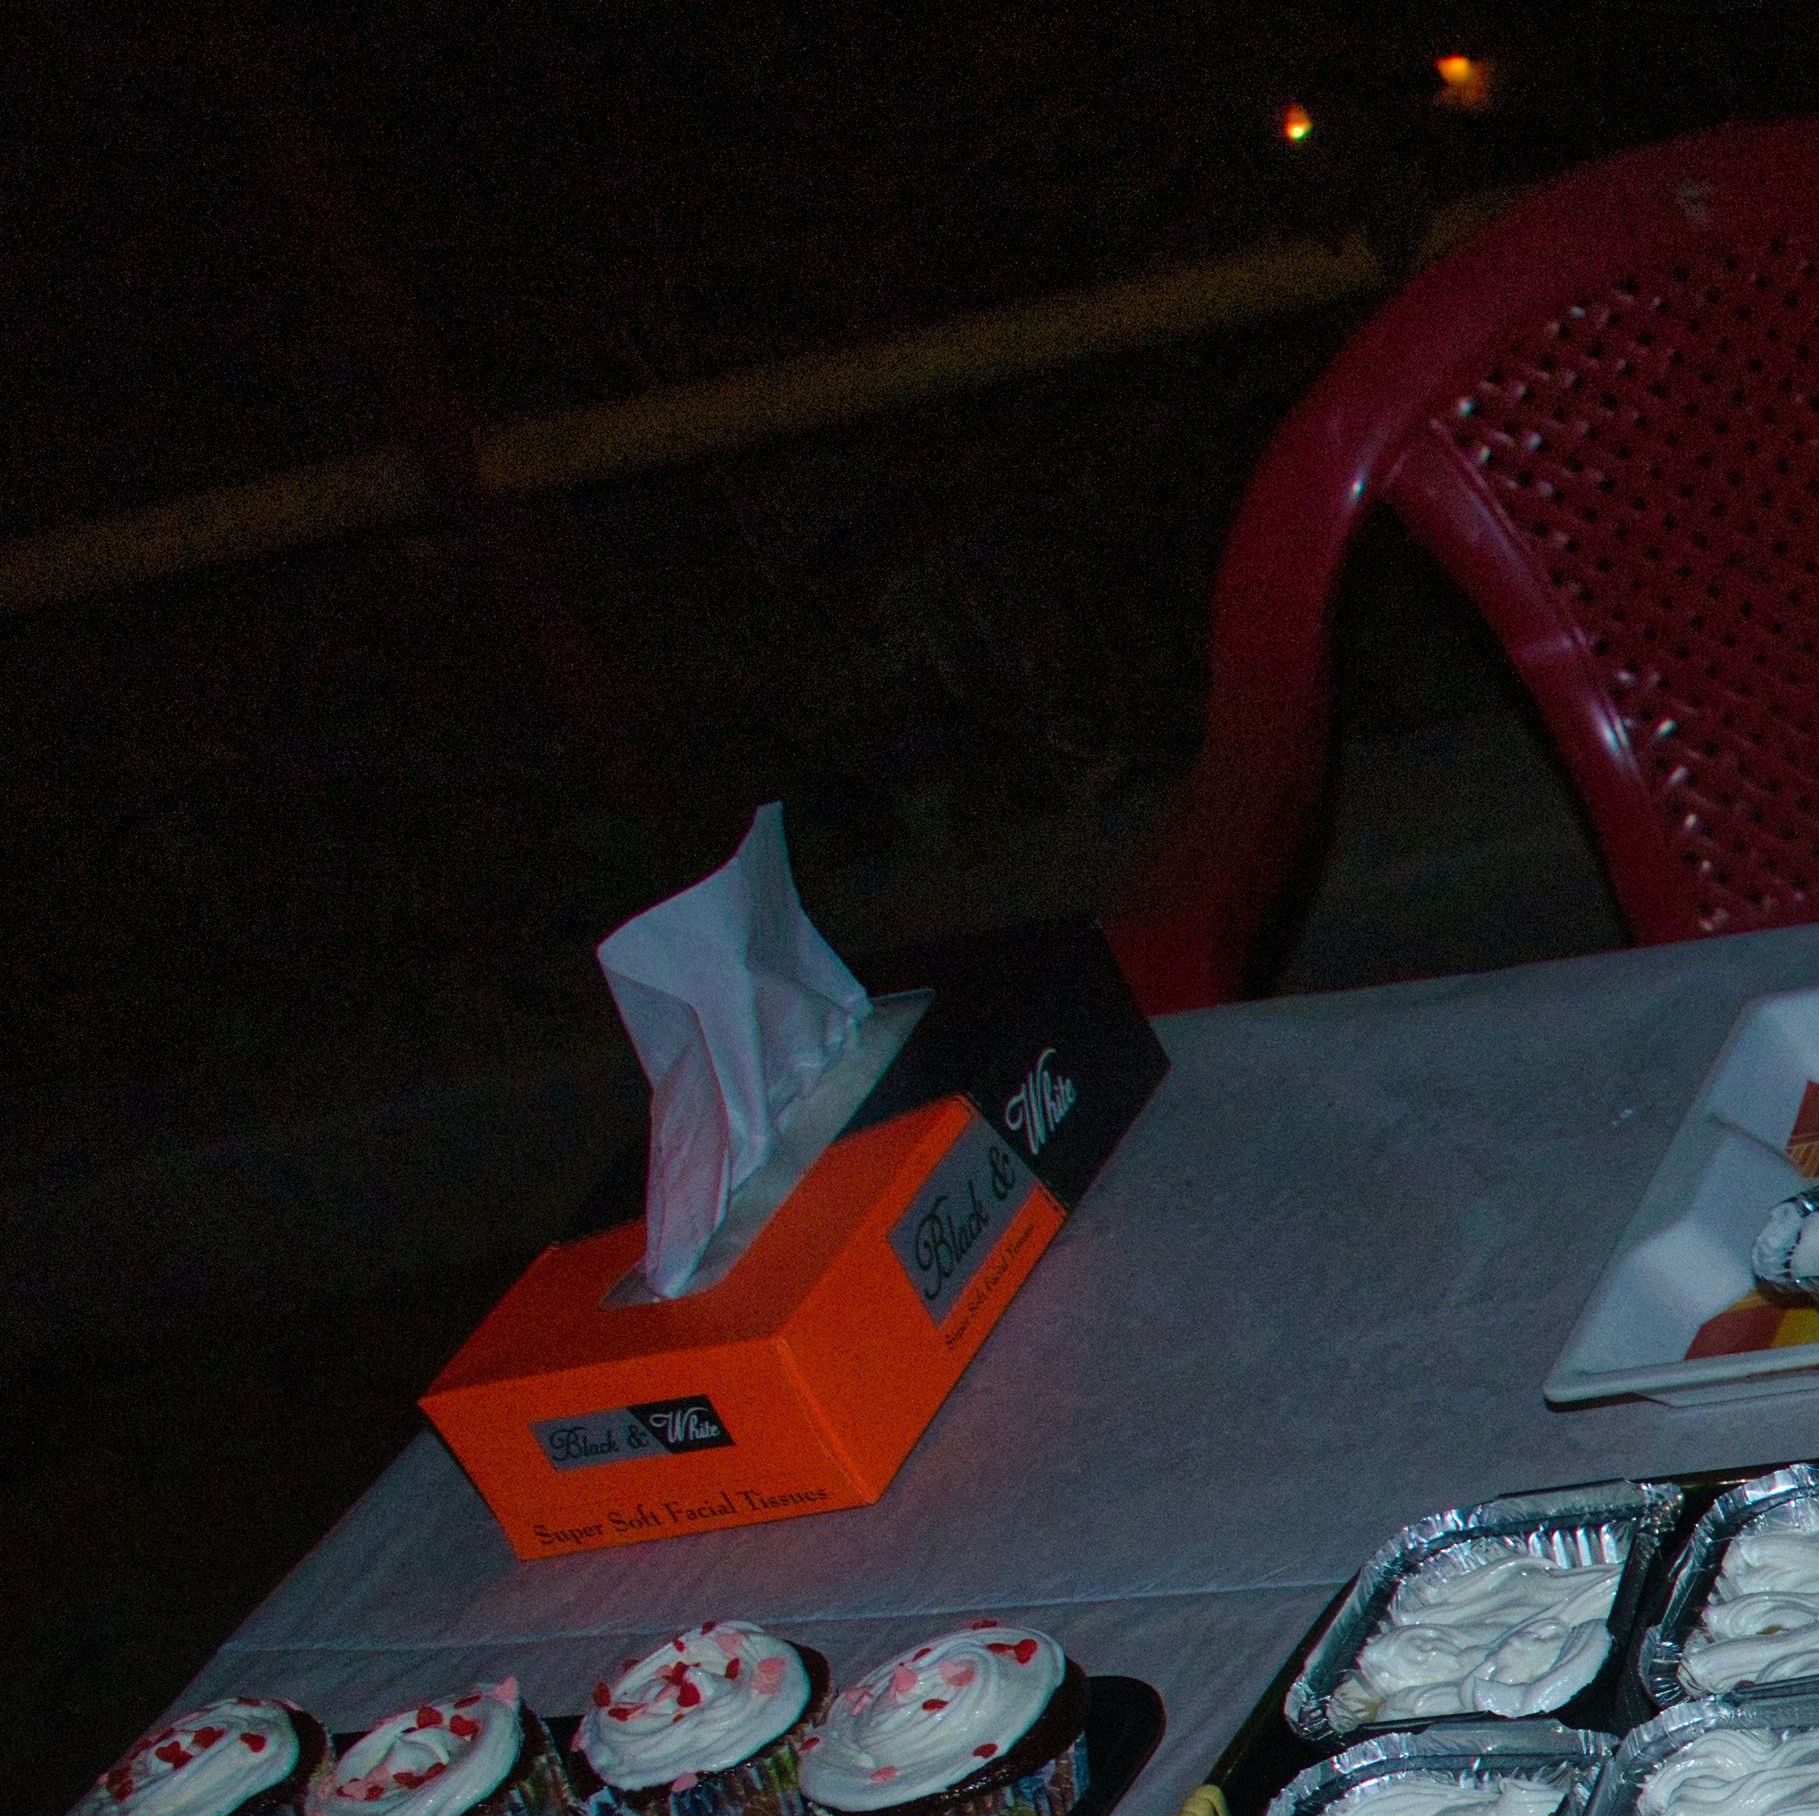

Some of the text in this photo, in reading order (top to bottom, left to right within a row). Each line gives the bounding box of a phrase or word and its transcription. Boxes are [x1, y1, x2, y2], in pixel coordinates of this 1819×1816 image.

[914, 1047, 1077, 1301] Black & White
[549, 1406, 720, 1462] Black & White
[533, 1486, 829, 1546] Super Soft Facial Tissues
